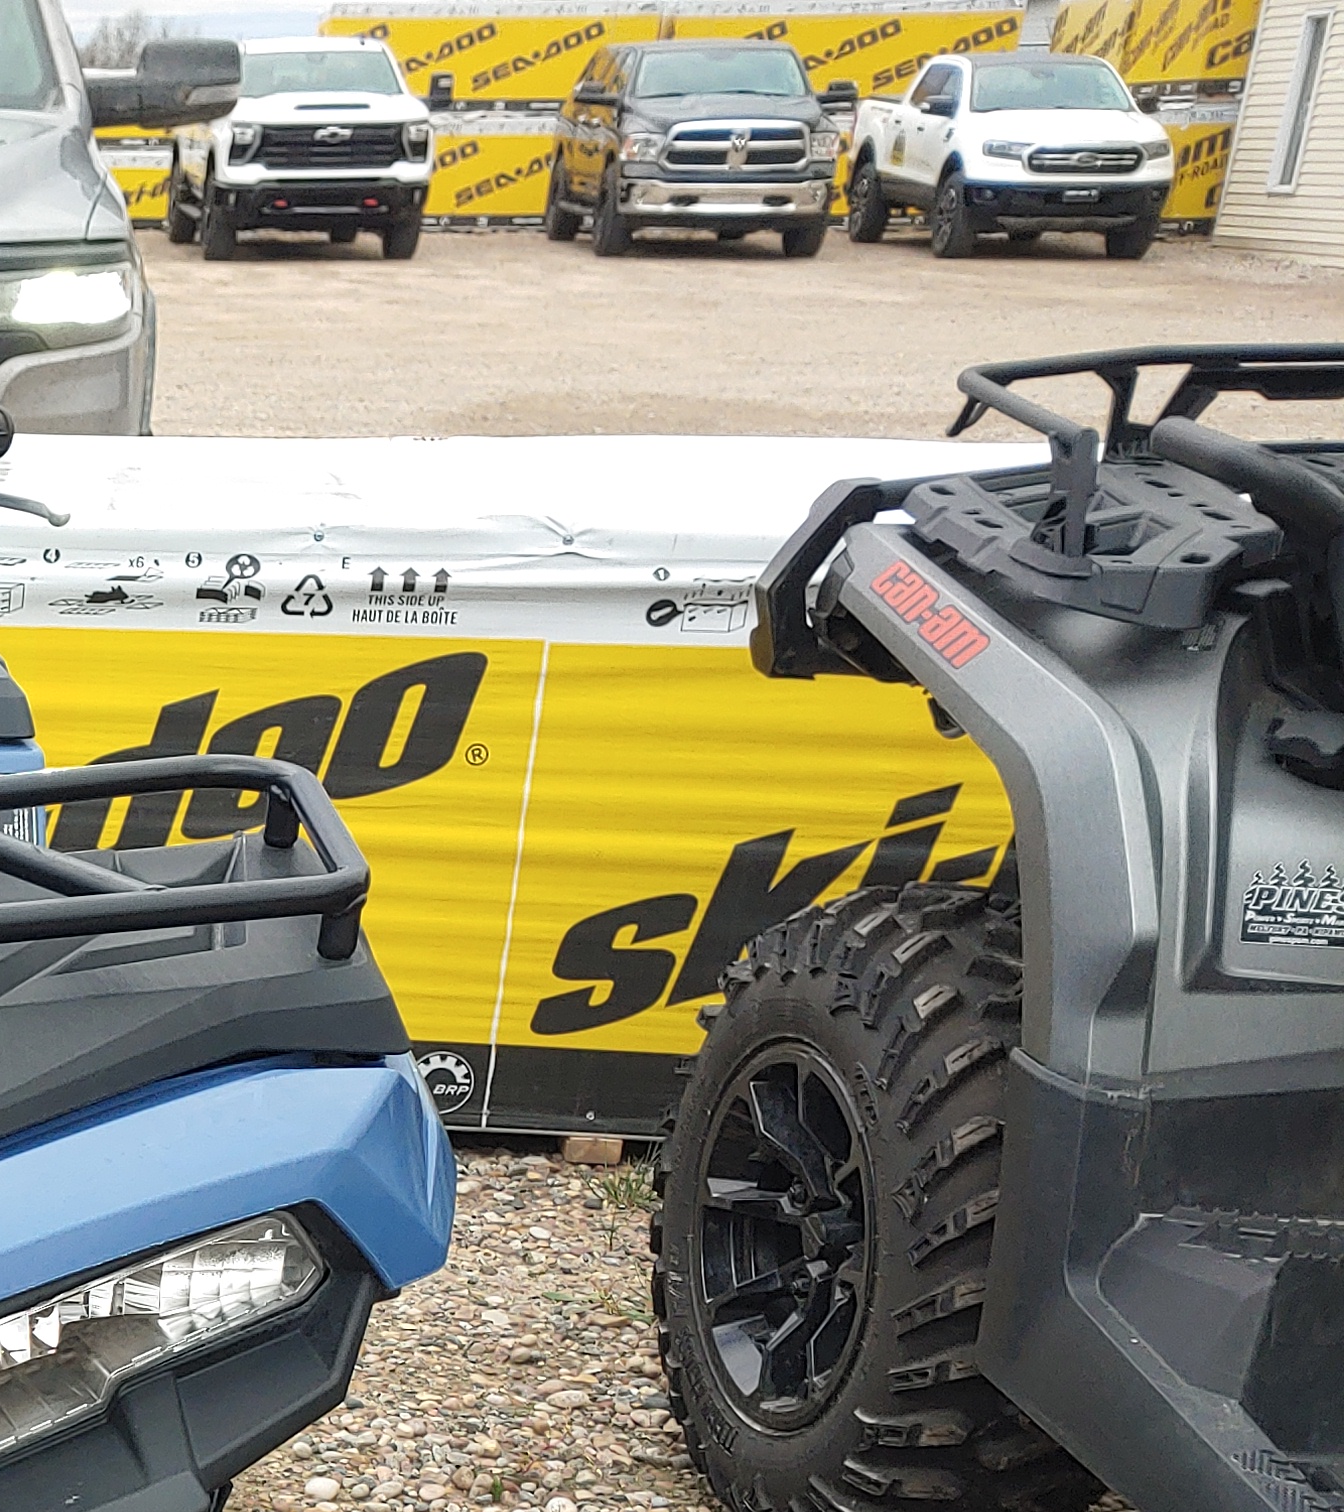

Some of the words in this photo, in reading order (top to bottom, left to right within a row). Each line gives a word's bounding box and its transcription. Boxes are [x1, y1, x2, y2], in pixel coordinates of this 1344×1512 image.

[368, 594, 395, 606] THIS
[397, 595, 425, 606] SIDE
[428, 596, 446, 607] UP
[352, 608, 384, 623] HAUT
[386, 610, 402, 623] DE
[404, 610, 418, 624] LA
[422, 606, 458, 625] BOÎTE
[870, 559, 991, 669] can-am
[433, 1084, 470, 1096] BRP
